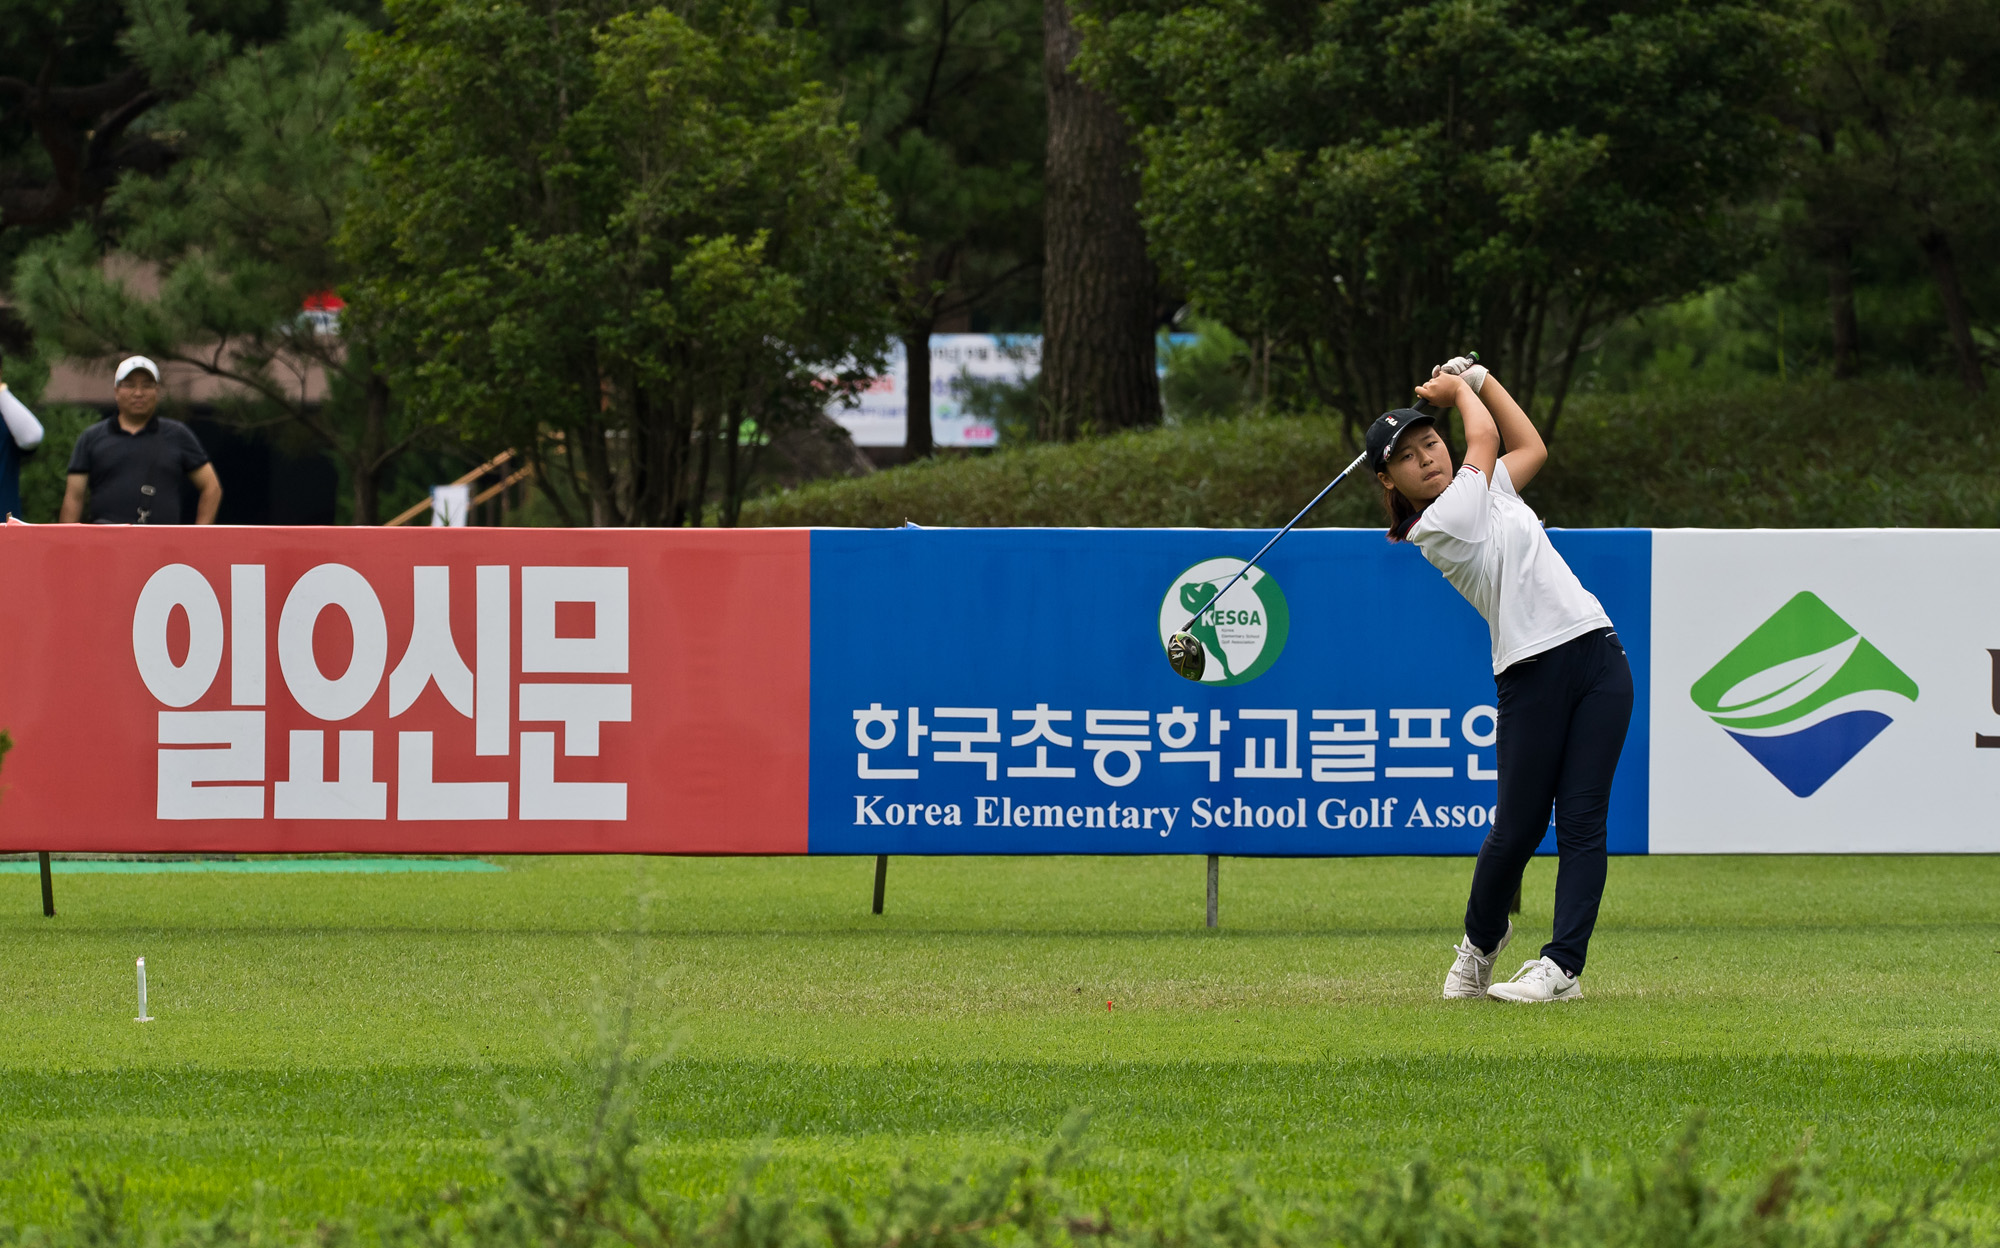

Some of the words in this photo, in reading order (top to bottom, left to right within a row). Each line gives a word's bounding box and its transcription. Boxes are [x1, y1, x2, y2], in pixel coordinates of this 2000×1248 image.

[1201, 610, 1262, 627] KESGA
[132, 563, 632, 820] 일요신문
[853, 795, 962, 826] Korea
[973, 796, 1180, 837] Elementary
[1191, 797, 1307, 829] School
[1317, 797, 1399, 829] Golf
